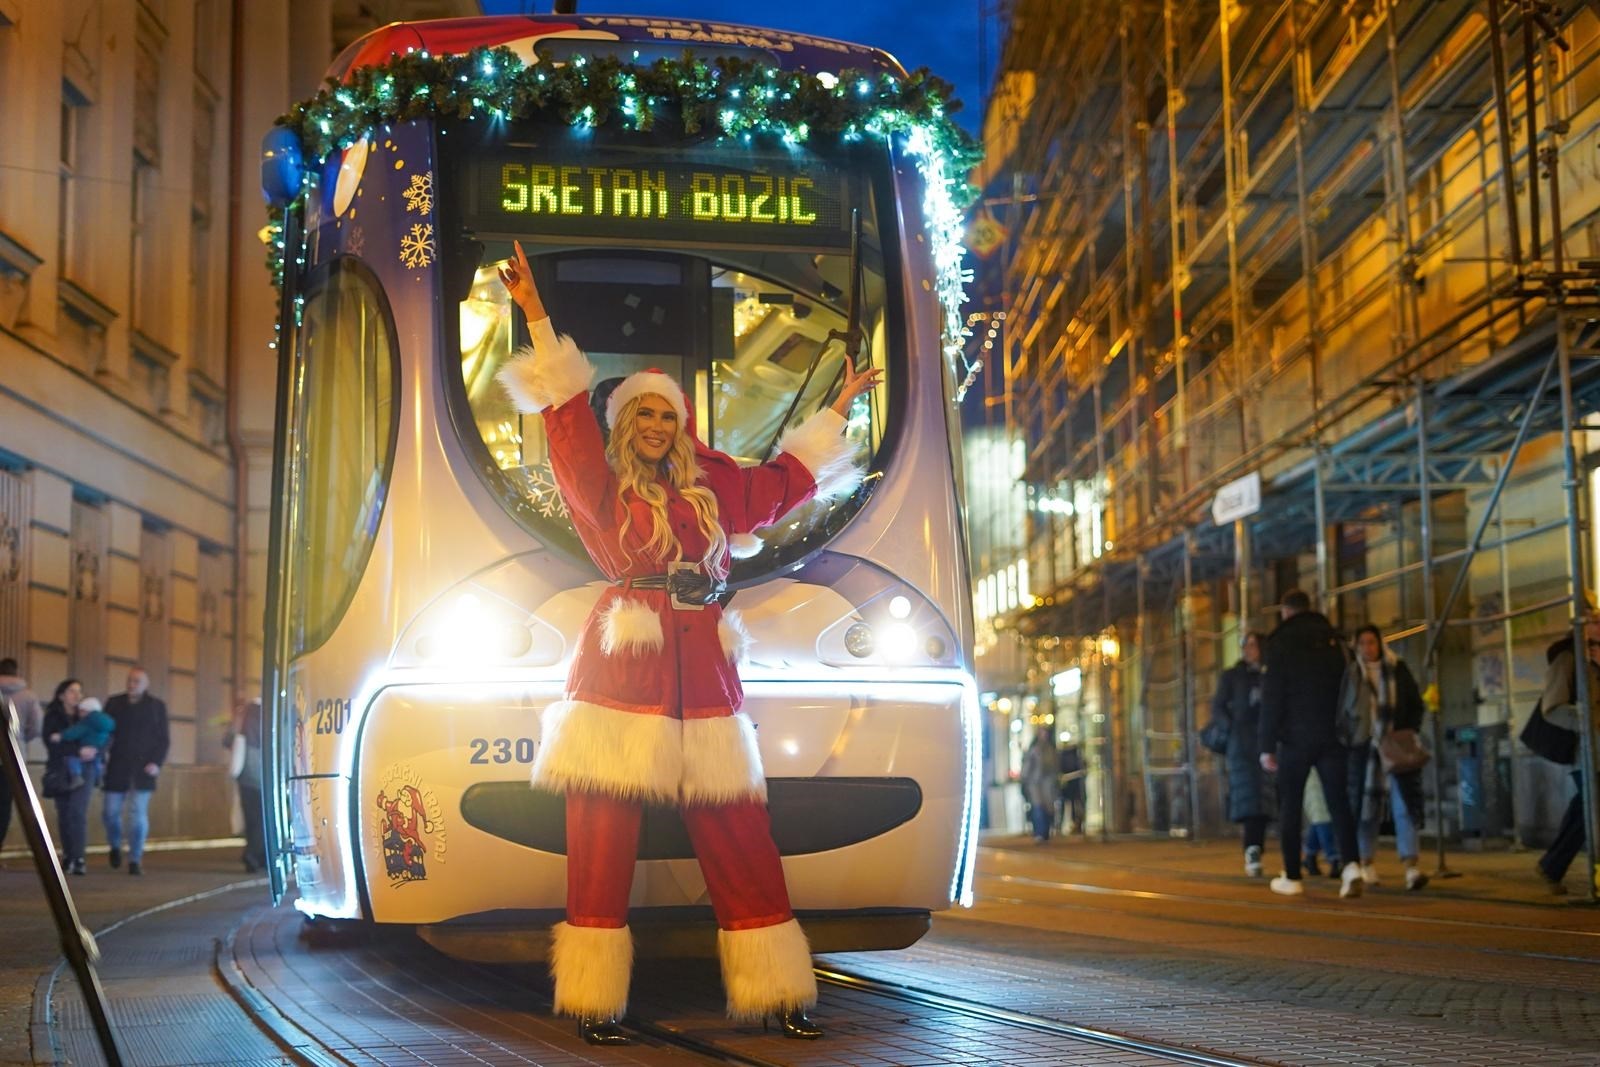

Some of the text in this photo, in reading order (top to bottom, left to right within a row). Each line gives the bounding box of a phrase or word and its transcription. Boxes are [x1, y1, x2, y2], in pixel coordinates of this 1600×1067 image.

[646, 27, 795, 52] TRAMVAJ
[501, 162, 668, 220] SRETAN
[315, 696, 352, 735] 2301
[469, 737, 541, 764] 230
